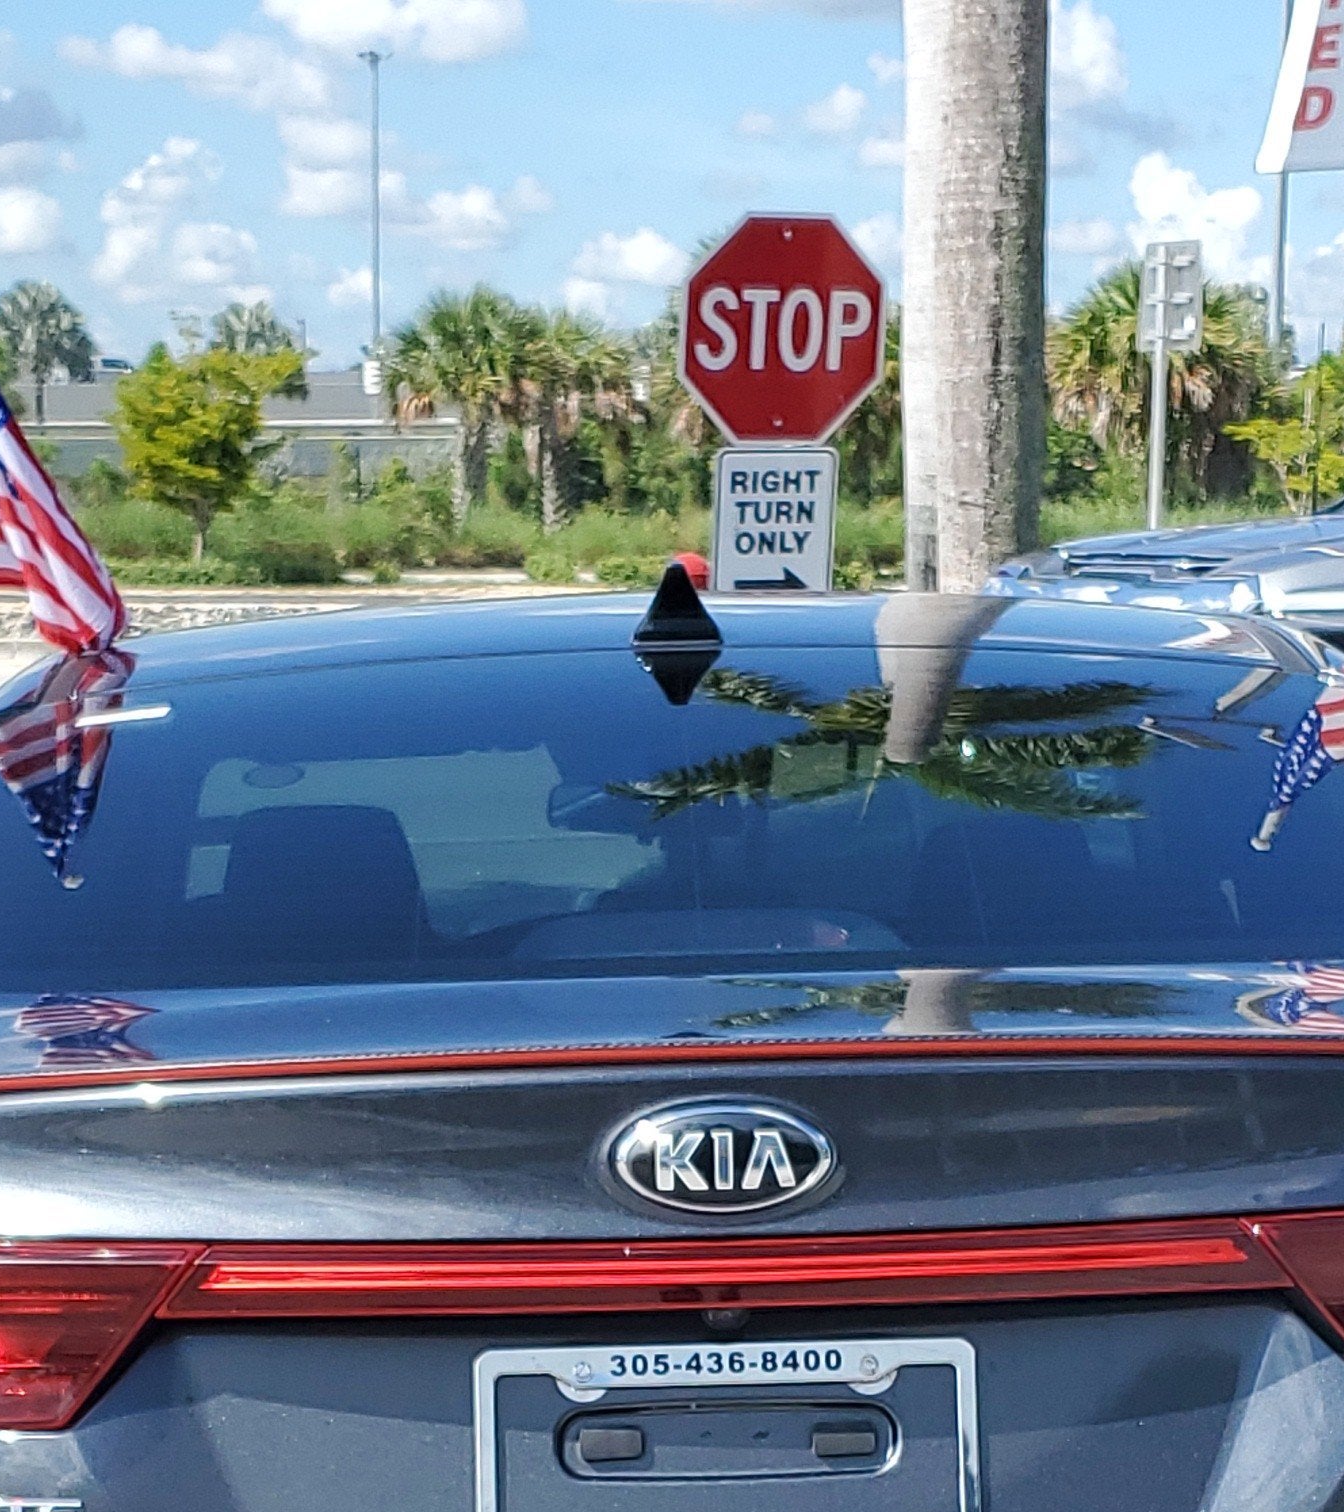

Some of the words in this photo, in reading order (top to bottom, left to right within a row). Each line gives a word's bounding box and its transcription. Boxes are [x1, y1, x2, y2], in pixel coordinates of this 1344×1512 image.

[1293, 0, 1344, 131] ED
[693, 286, 872, 373] STOP
[730, 470, 822, 495] RIGHT
[735, 501, 816, 525] TURN
[735, 531, 812, 555] ONLY
[655, 1128, 797, 1191] KIA
[609, 1348, 843, 1378] 305-436-8400
